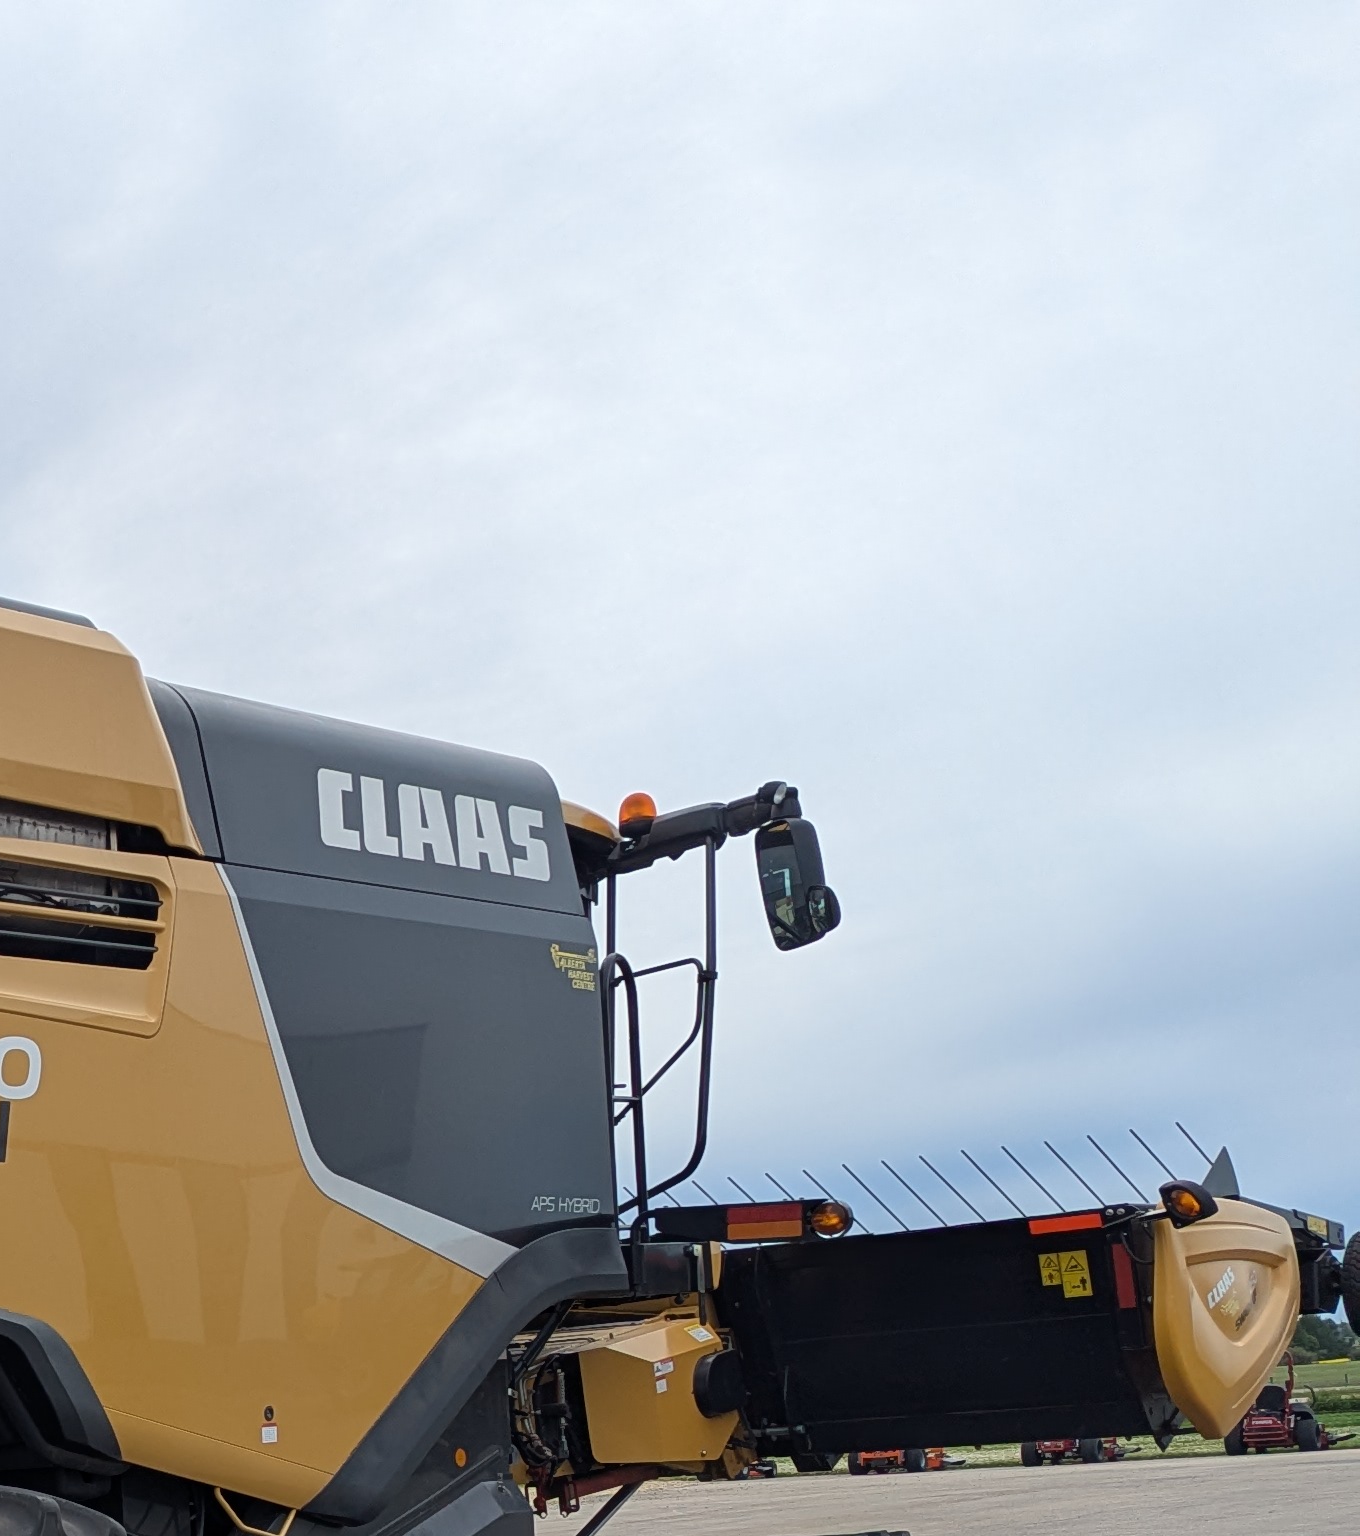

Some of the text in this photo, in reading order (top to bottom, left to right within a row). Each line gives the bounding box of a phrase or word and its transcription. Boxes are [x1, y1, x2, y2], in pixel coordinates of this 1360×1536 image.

[317, 767, 551, 882] CLAAS
[530, 1195, 601, 1214] APS HYBRID
[1206, 1265, 1236, 1310] CLAAS
